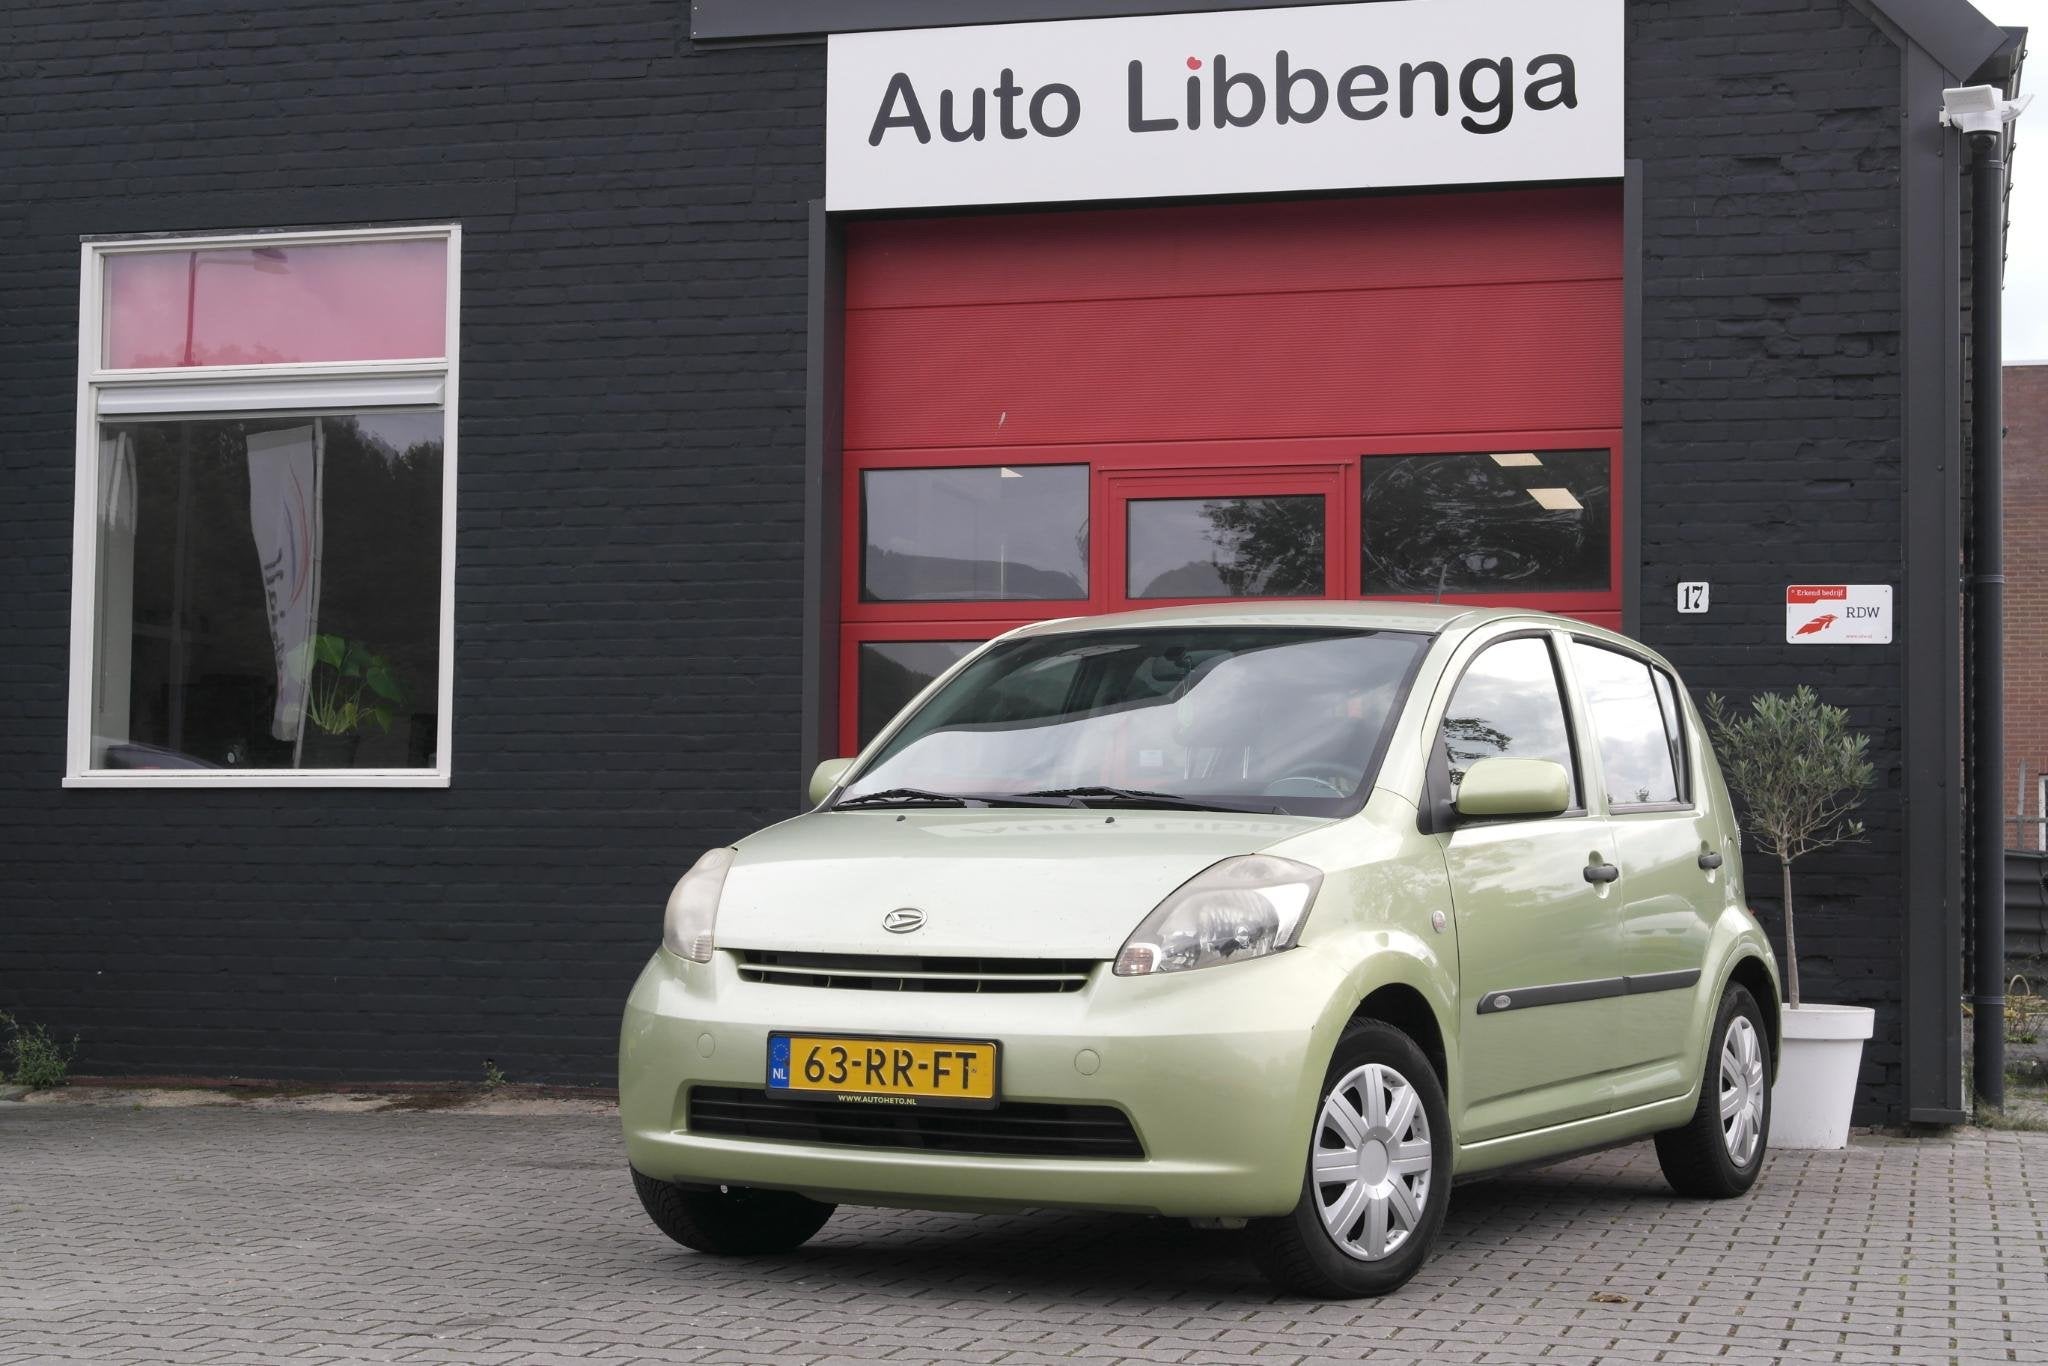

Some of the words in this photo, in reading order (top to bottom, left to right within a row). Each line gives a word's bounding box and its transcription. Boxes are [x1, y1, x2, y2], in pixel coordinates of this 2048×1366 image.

[868, 68, 1081, 147] Auto
[1128, 49, 1578, 135] Libbenga
[1683, 585, 1704, 610] 17
[1846, 606, 1880, 619] RDW
[772, 1067, 787, 1080] NL
[804, 1045, 977, 1090] 63-RR-FT
[837, 1093, 917, 1106] WWW.AUTOHETO.NL
